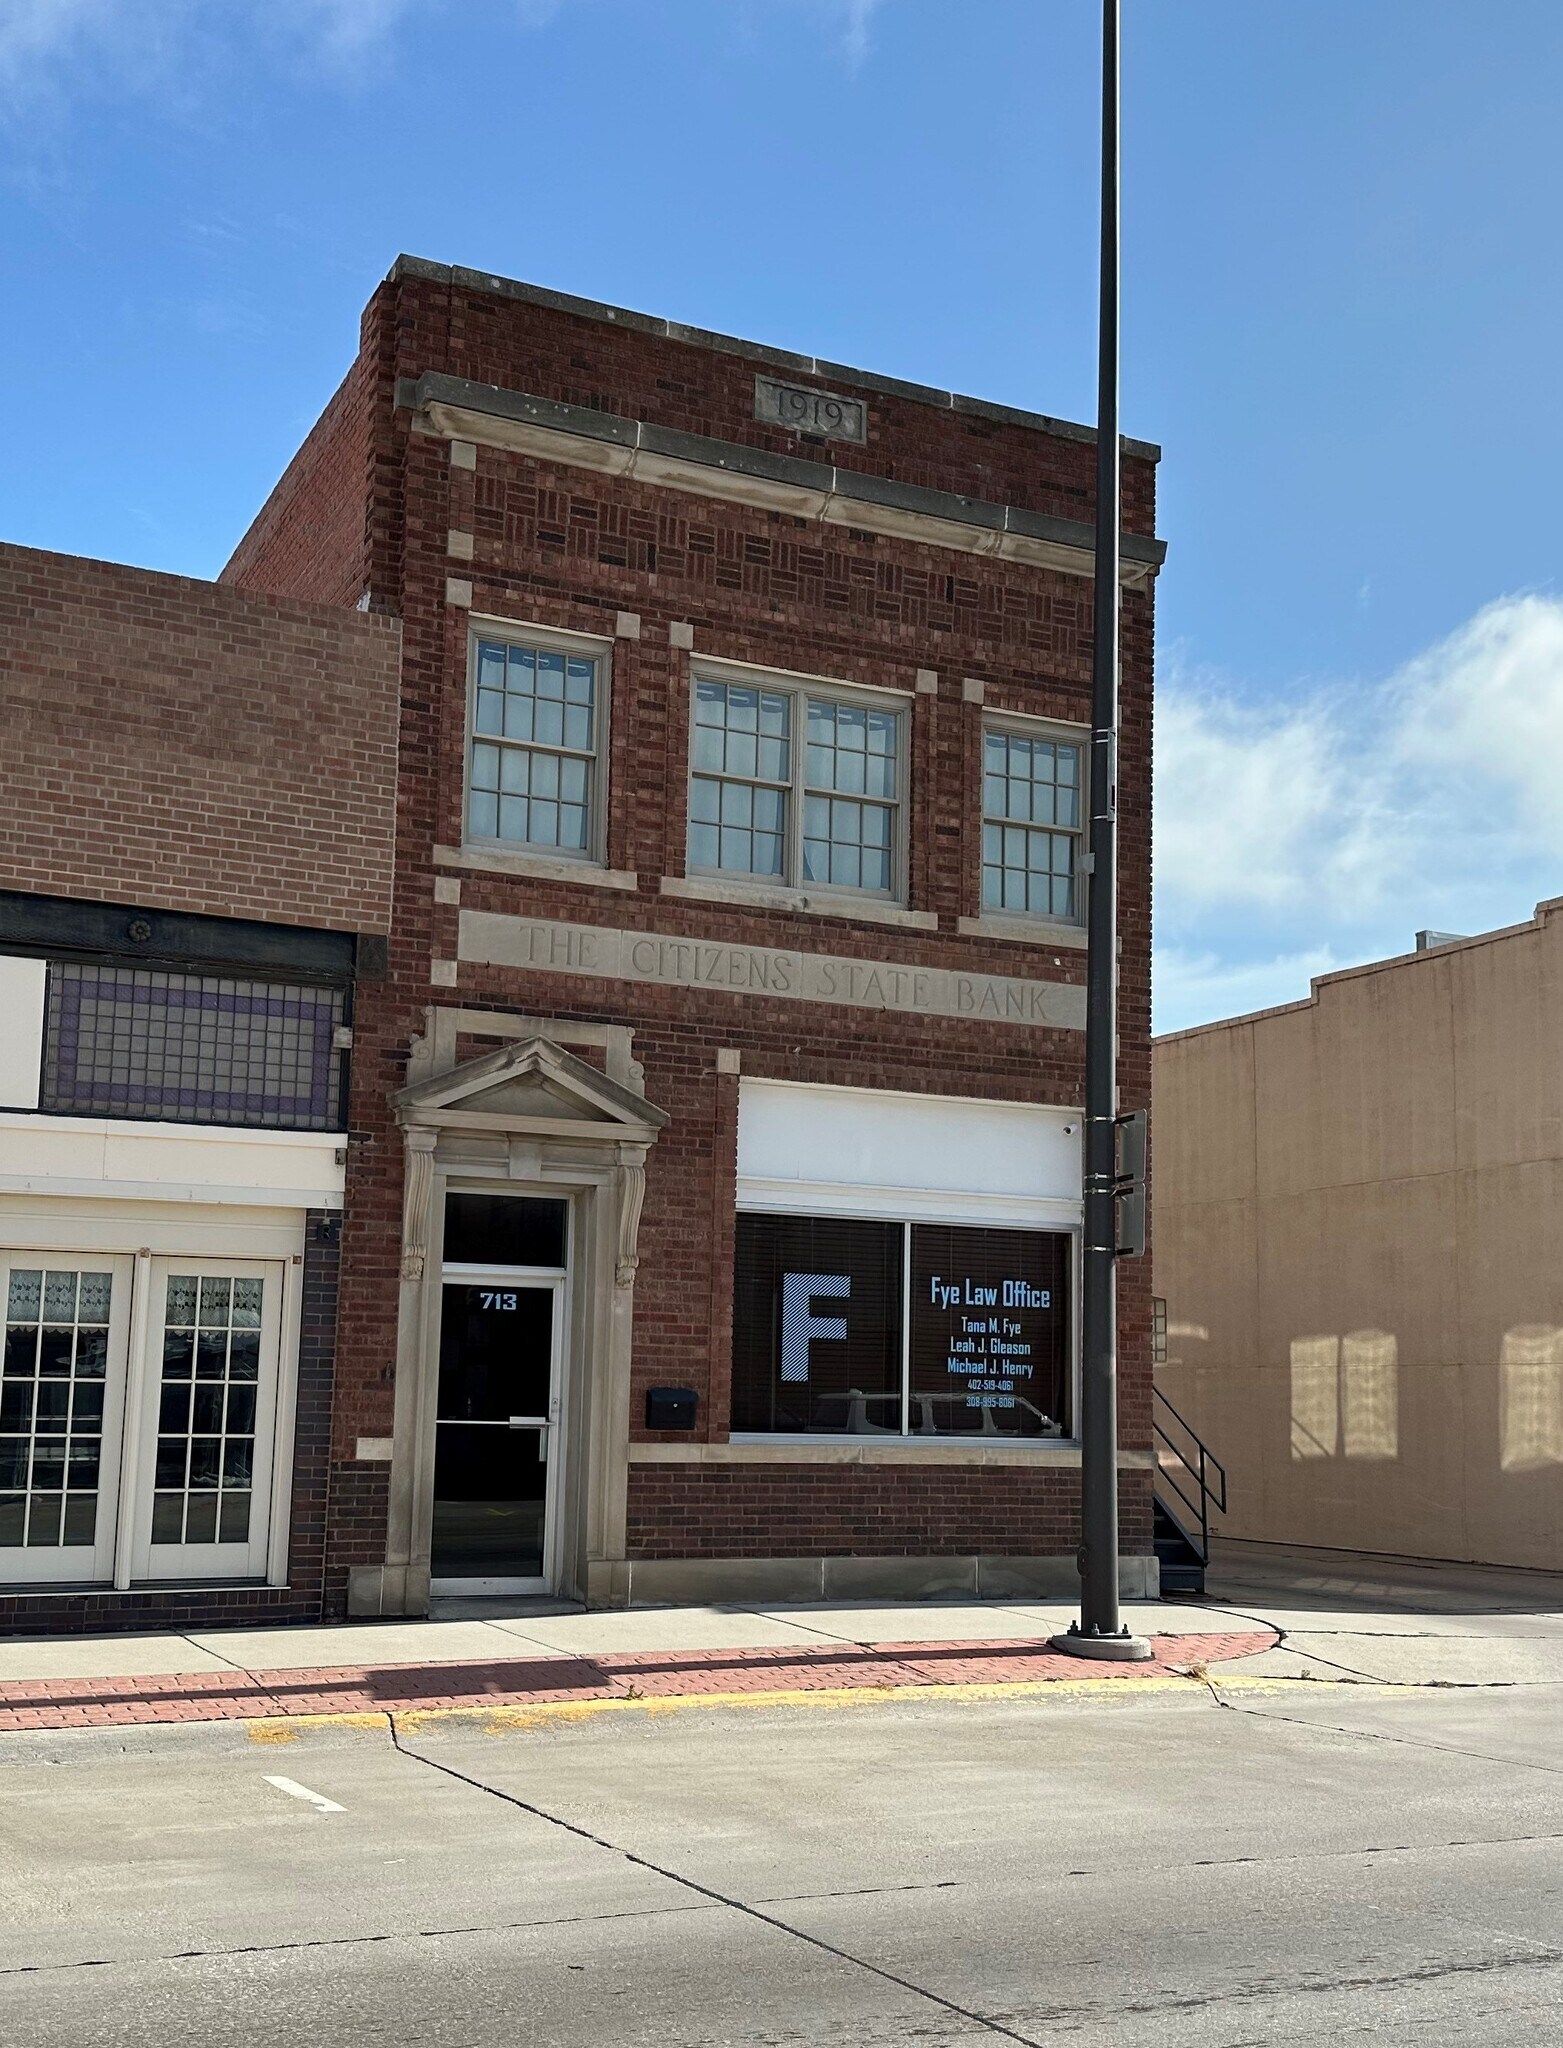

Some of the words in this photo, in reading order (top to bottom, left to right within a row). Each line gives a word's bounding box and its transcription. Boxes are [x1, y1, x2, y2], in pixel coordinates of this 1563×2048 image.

[778, 391, 843, 428] 1919
[519, 924, 598, 969] THE
[631, 939, 793, 991] CITIZENS
[816, 962, 931, 1007] STATE
[956, 978, 1048, 1020] BANK
[480, 1292, 517, 1311] 713
[931, 1276, 960, 1310] Fye
[965, 1278, 998, 1306] Law
[1002, 1280, 1051, 1308] Office
[780, 1272, 851, 1382] F
[961, 1316, 986, 1333] Tana
[988, 1317, 1000, 1334] M.
[1003, 1318, 1021, 1337] Fye
[950, 1336, 975, 1353] Leah
[977, 1337, 987, 1354] J.
[990, 1337, 1031, 1355] Gleason
[947, 1357, 987, 1374] Michael
[989, 1358, 999, 1375] J.
[1002, 1359, 1033, 1379] Henry
[967, 1379, 1014, 1391] 402-519-4061
